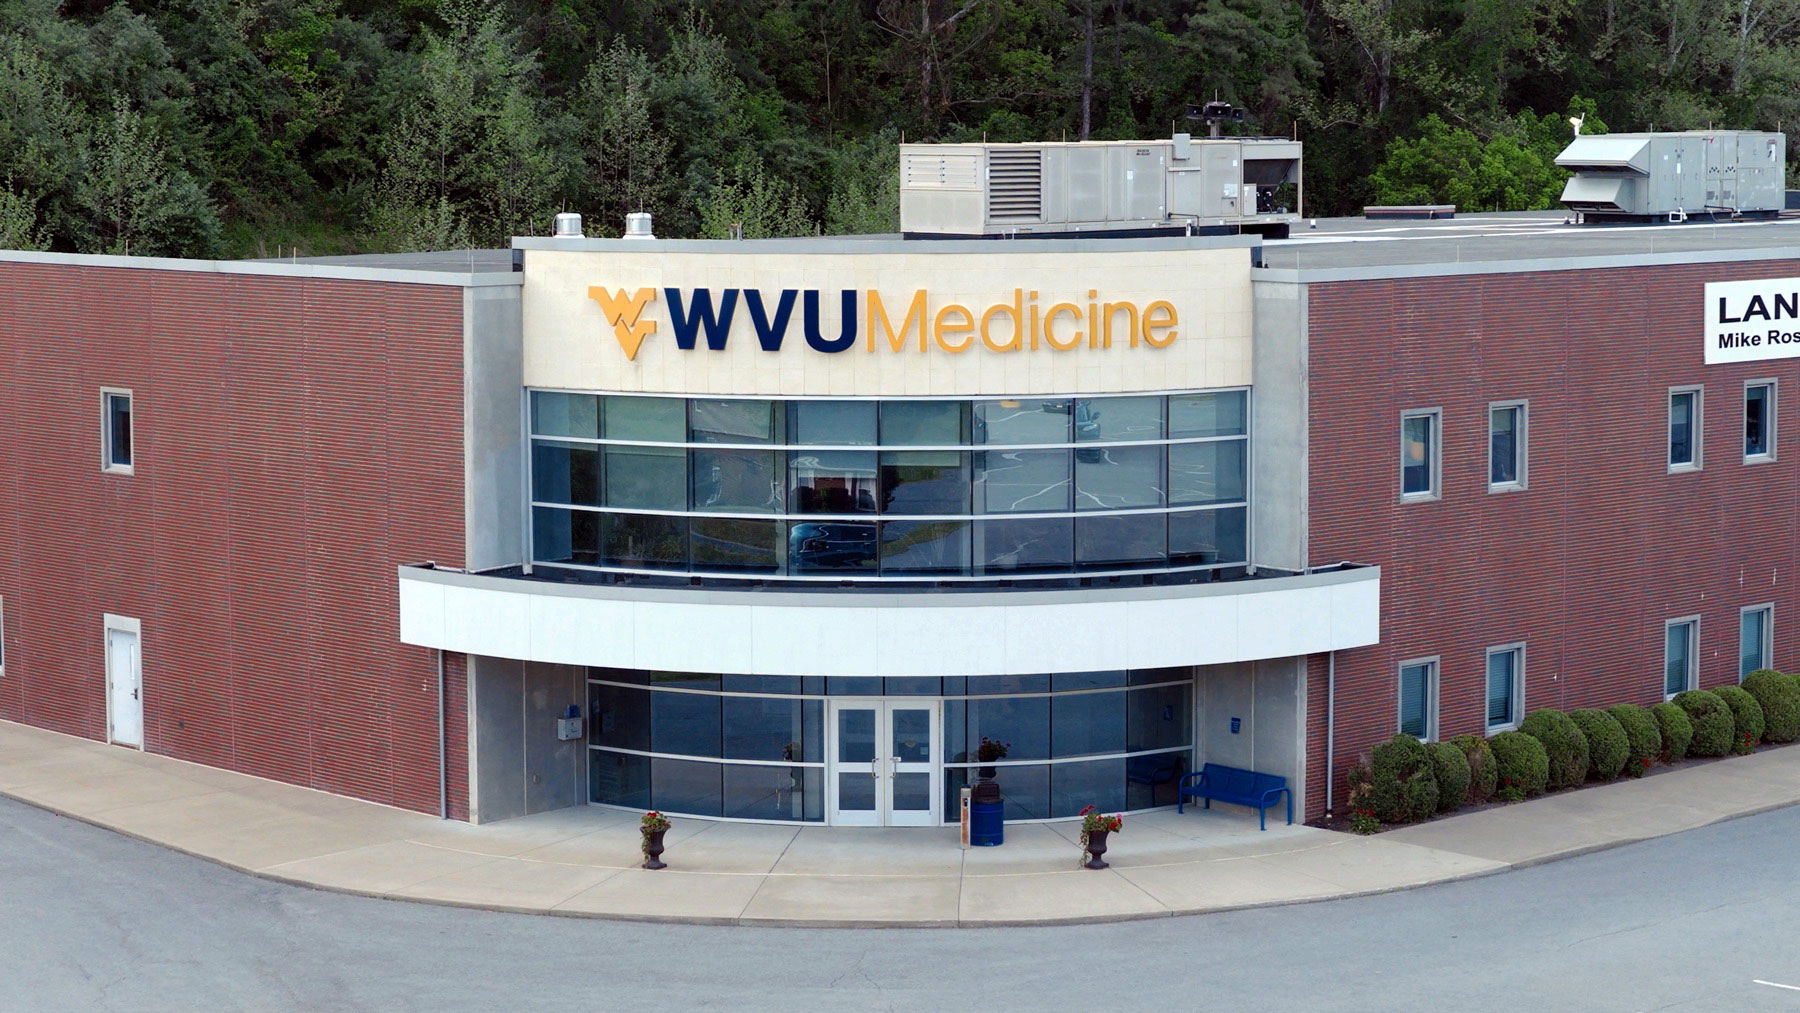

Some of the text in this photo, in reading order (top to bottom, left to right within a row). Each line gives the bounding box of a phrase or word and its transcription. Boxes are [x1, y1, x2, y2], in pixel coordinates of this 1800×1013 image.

[664, 287, 1178, 353] WVU Medicine
[1719, 292, 1799, 324] LAN
[1718, 329, 1800, 349] Mike Ros
